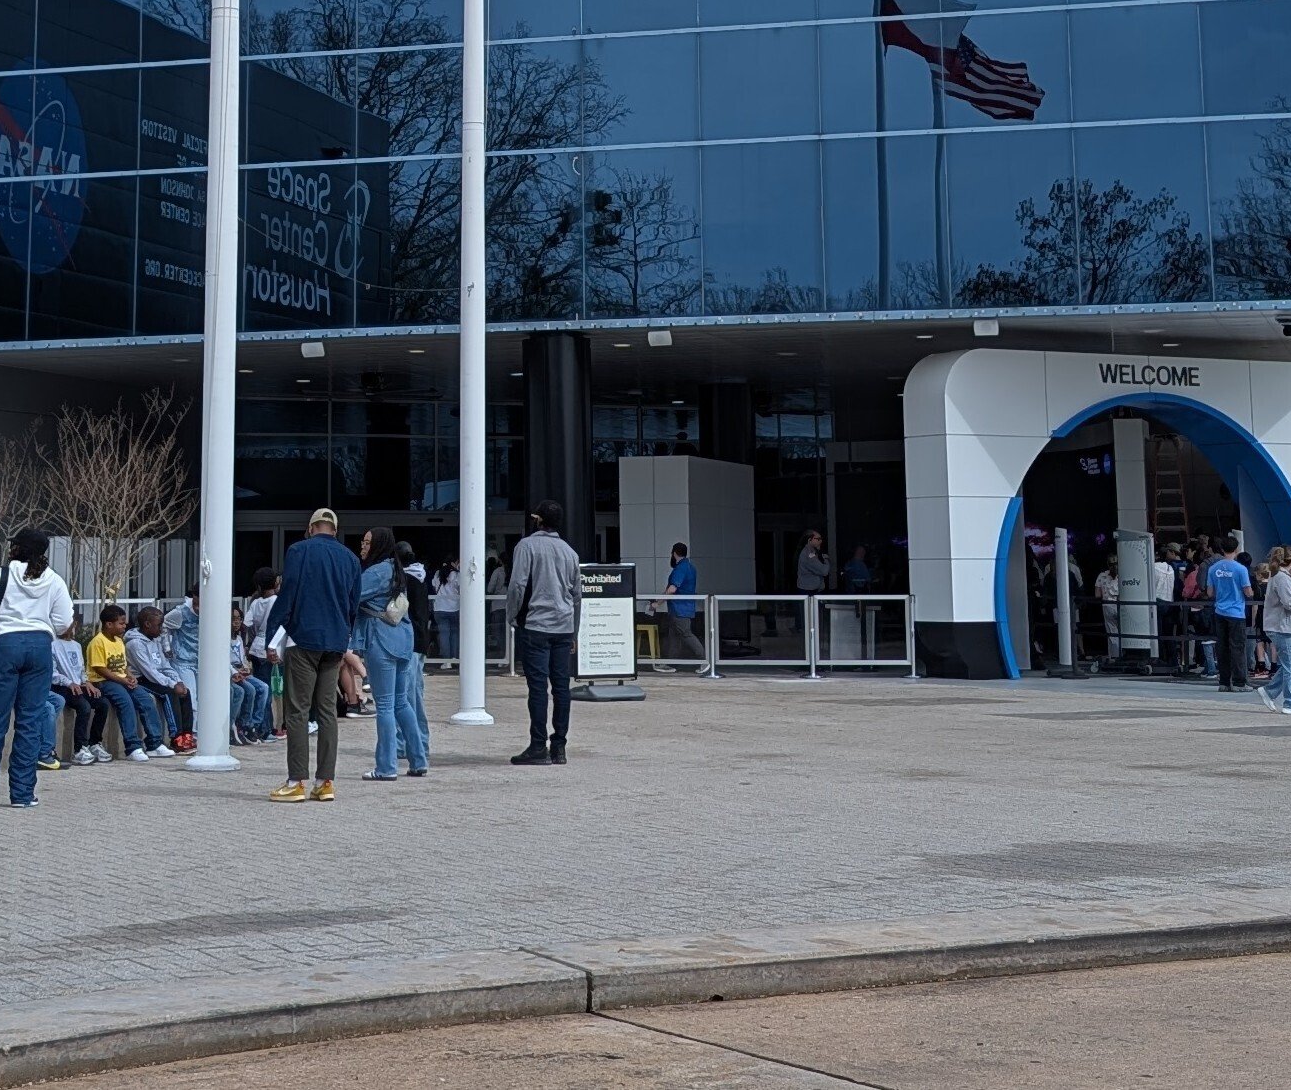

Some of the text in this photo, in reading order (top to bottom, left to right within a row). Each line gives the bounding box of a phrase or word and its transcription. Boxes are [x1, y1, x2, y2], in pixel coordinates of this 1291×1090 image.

[1098, 362, 1201, 387] WELCOME
[580, 573, 622, 584] Prohibited
[581, 585, 603, 593] tems
